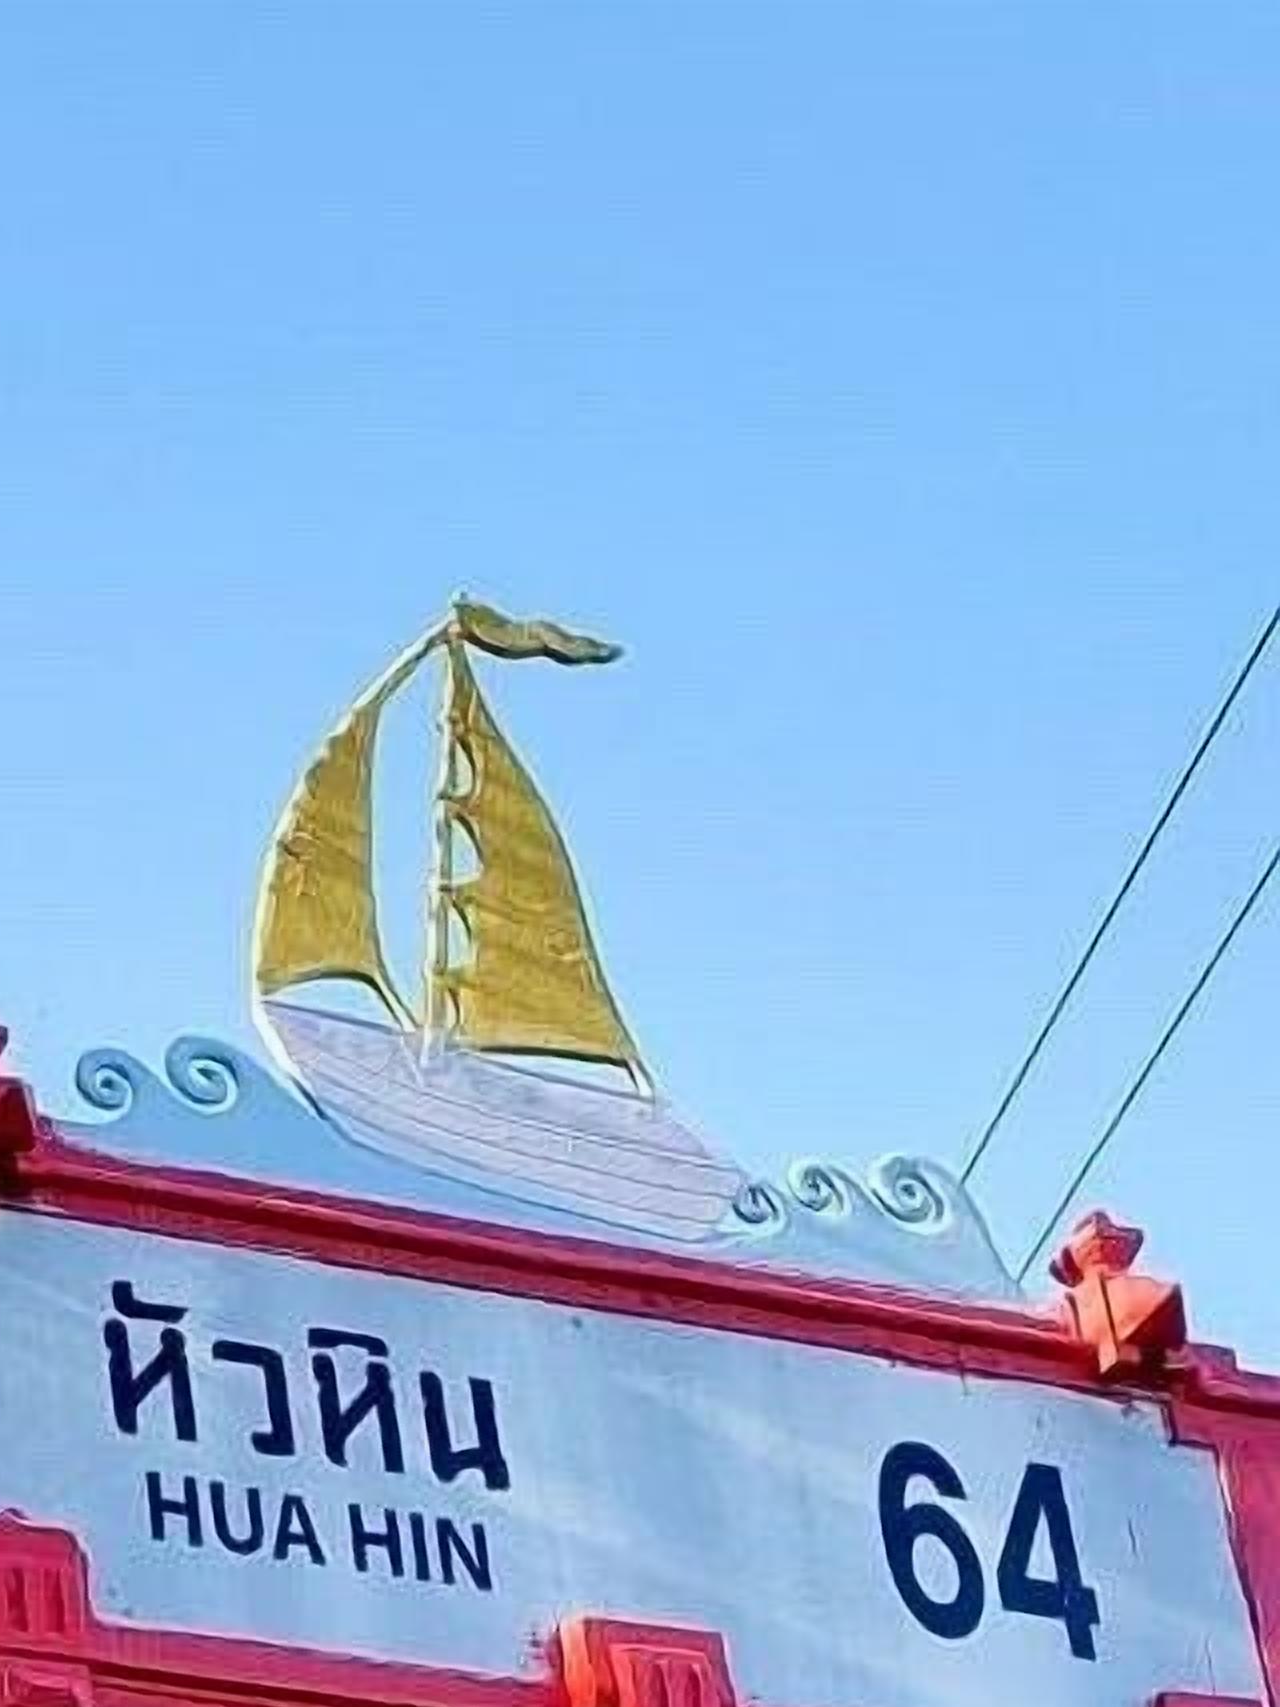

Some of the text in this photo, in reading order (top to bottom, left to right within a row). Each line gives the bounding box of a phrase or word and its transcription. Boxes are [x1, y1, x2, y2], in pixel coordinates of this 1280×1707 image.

[103, 1280, 511, 1491] หัวหิน
[145, 1471, 493, 1592] HUA HIN
[875, 1440, 1099, 1661] 64
